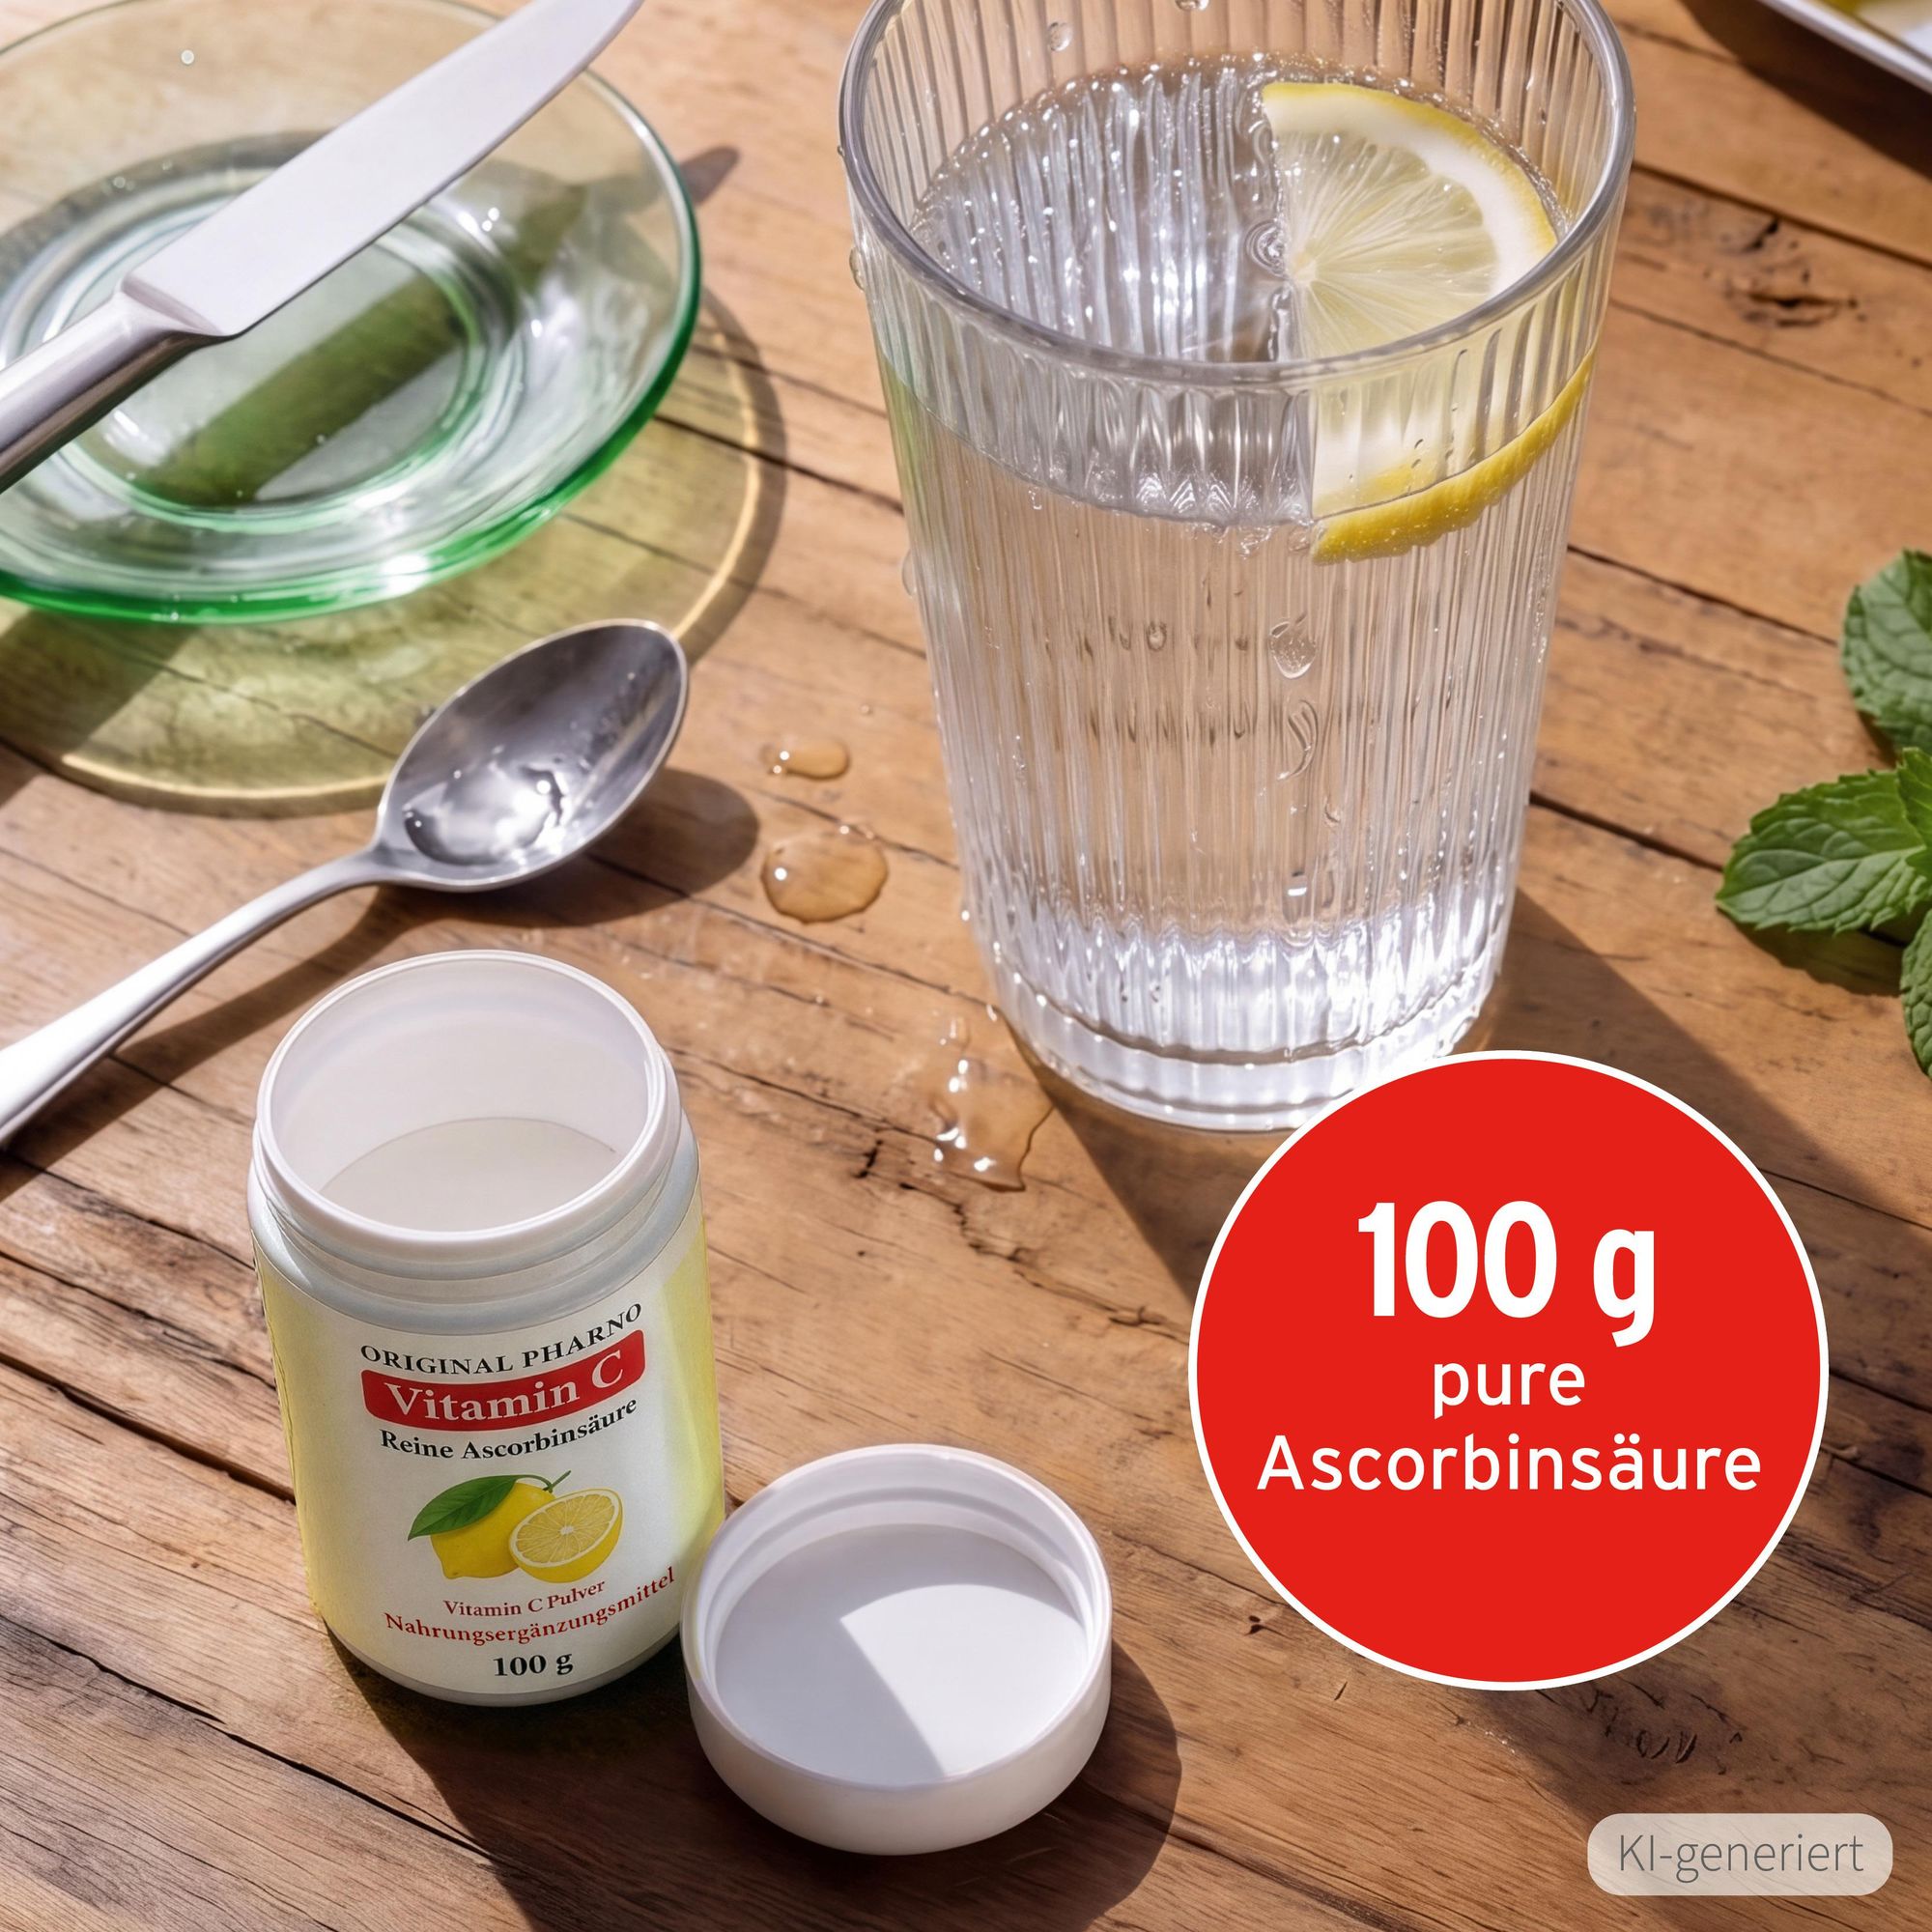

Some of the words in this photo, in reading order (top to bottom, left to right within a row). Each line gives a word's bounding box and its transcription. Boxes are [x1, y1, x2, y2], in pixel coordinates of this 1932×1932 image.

[360, 1345, 513, 1375] ORIGINAL
[522, 1303, 641, 1368] PHARNO
[384, 1380, 580, 1422] Vitamin
[591, 1350, 624, 1388] C
[379, 1429, 454, 1459] Reine
[462, 1399, 638, 1460] Ascorbinsäure
[384, 1566, 675, 1646] Nahrungsergänzungsmittel
[442, 1600, 523, 1617] Vitamin
[527, 1599, 543, 1613] C
[547, 1580, 606, 1610] Pulver
[493, 1655, 547, 1677] 100
[555, 1653, 574, 1676] g
